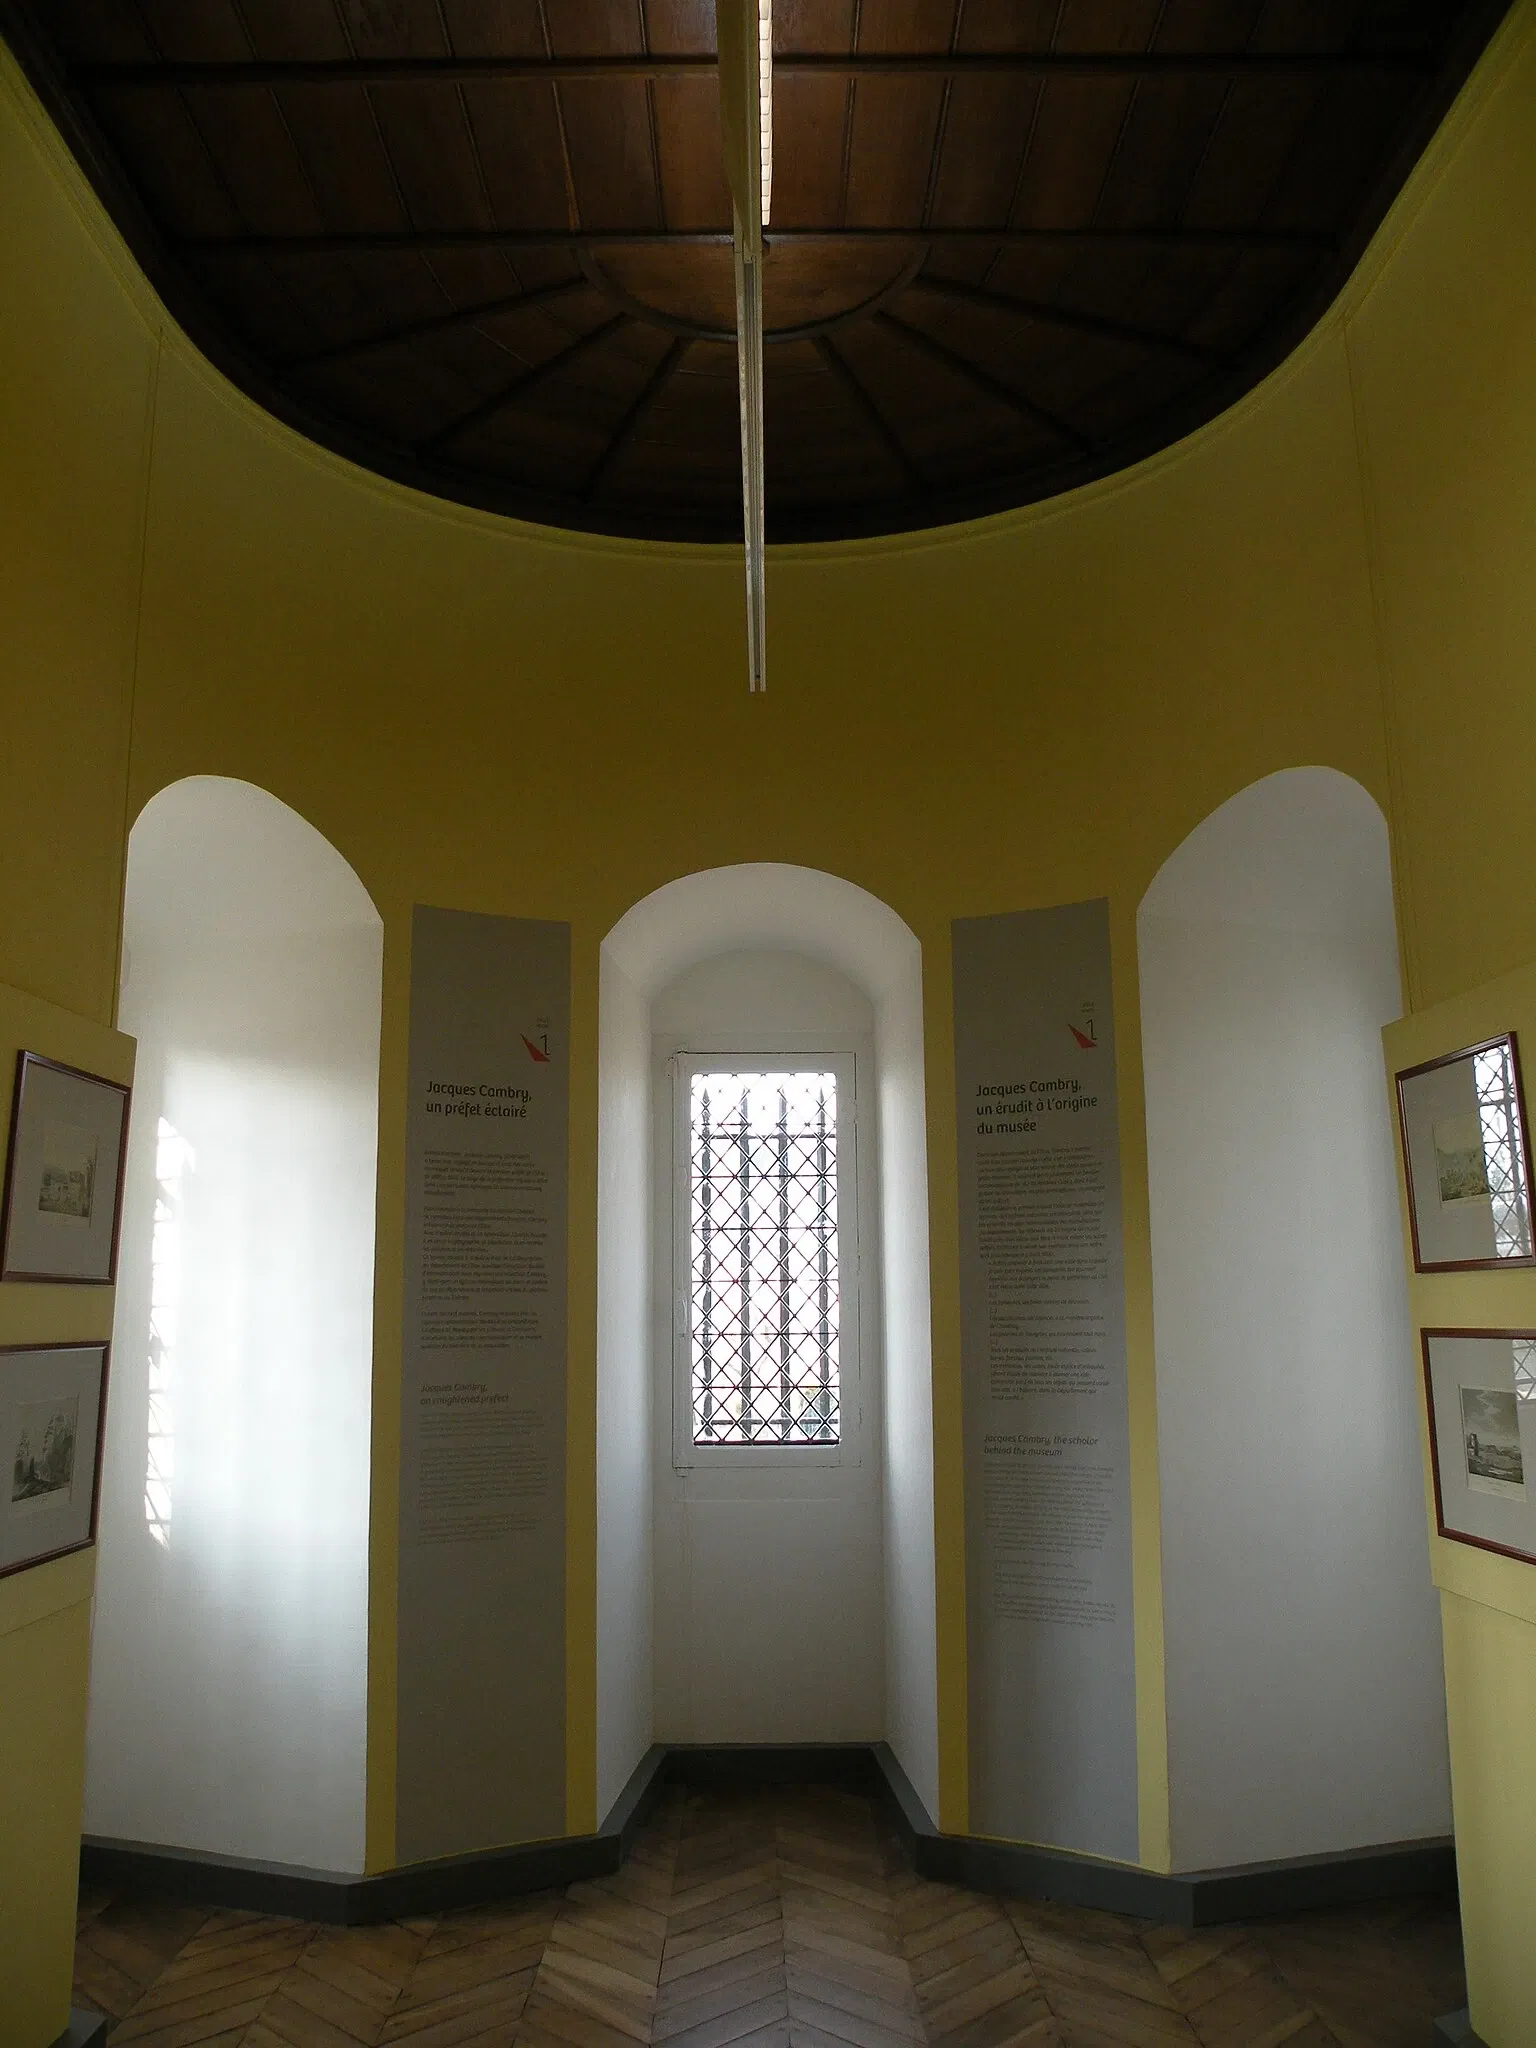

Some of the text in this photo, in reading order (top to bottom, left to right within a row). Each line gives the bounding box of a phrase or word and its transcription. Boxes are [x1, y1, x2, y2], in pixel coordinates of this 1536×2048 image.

[1086, 1019, 1098, 1040] 1
[539, 1034, 551, 1056] 1
[426, 1081, 532, 1103] Jacques Cambry,
[976, 1078, 1083, 1098] Jacques Cambry,
[426, 1101, 527, 1118] un préfet éclairé
[976, 1105, 993, 1116] un
[995, 1100, 1033, 1115] érudit
[1035, 1099, 1045, 1113] à
[976, 1118, 1037, 1134] du musée
